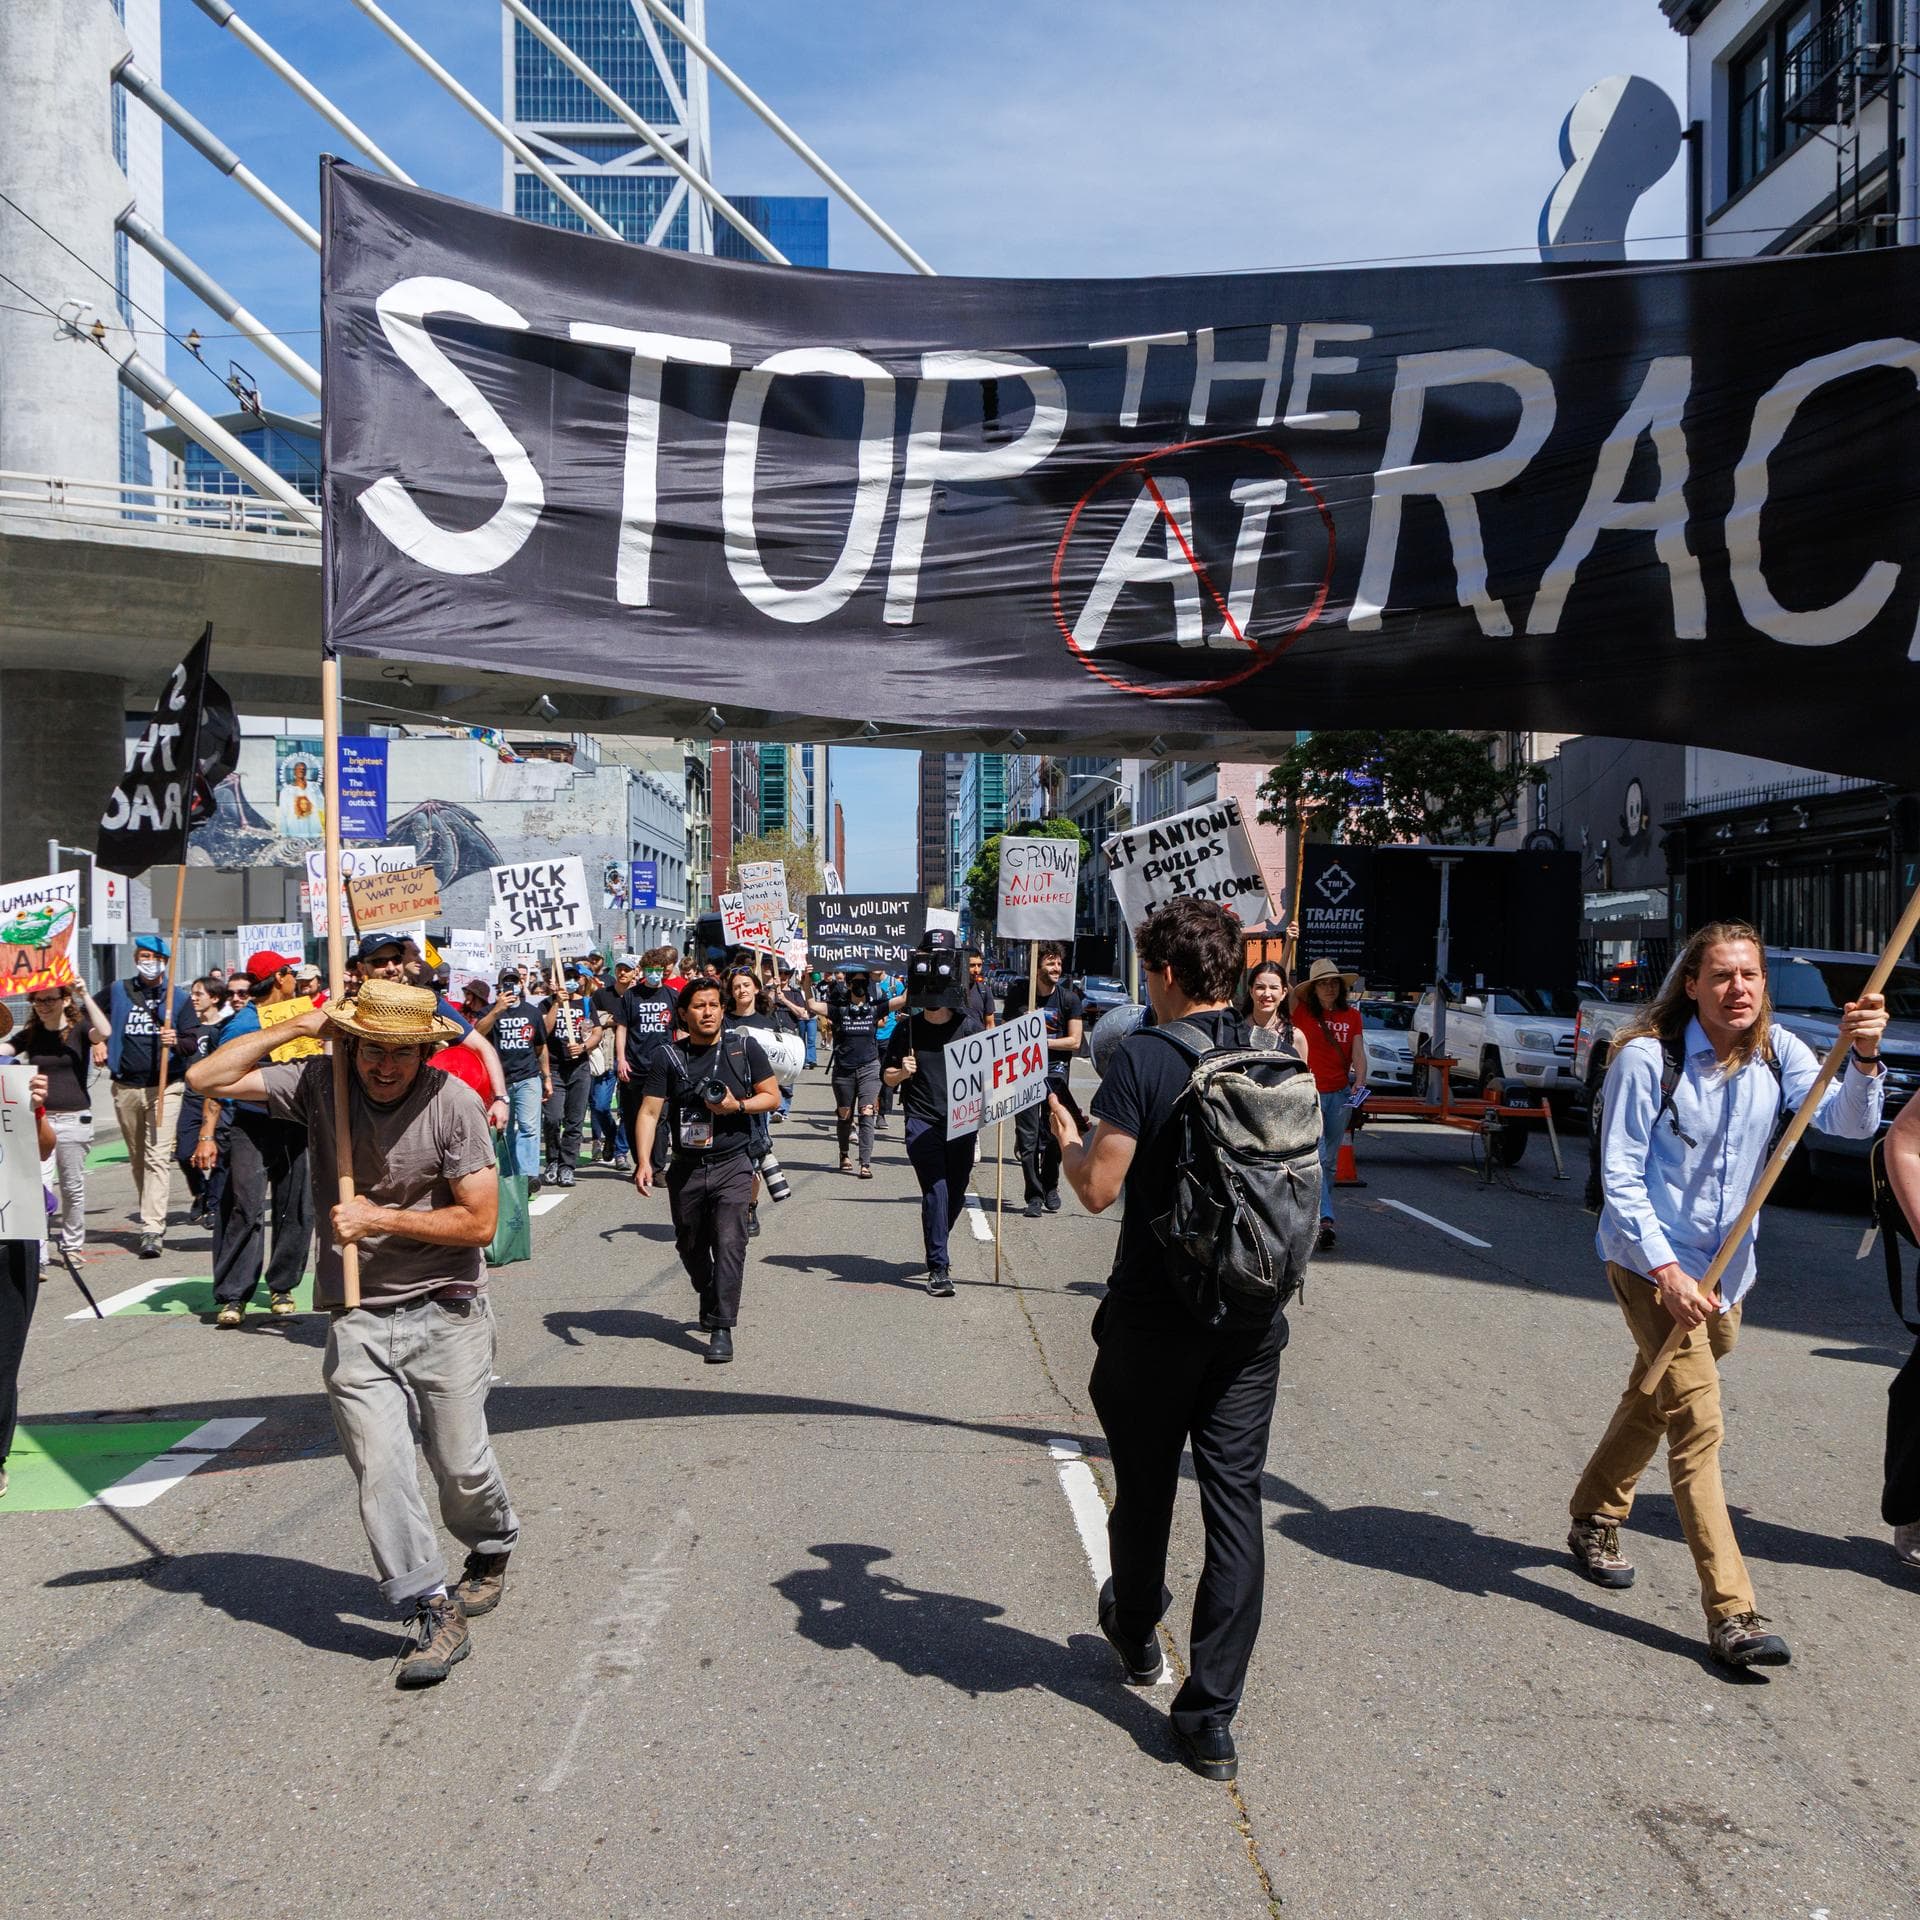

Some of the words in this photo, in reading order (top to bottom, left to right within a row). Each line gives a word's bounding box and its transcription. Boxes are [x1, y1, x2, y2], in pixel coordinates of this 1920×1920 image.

[1089, 323, 1374, 431] THE
[356, 275, 1068, 625] STOP
[1347, 337, 1920, 663] RAC
[1072, 476, 1288, 651] AI
[1110, 836, 1136, 871] IF
[1149, 803, 1241, 853] ANYONE
[310, 852, 366, 878] COs
[1006, 845, 1077, 878] GROWN
[1143, 838, 1224, 881] BUILDS
[352, 876, 384, 893] DON'T
[386, 872, 410, 883] CALL
[410, 870, 425, 879] UP
[497, 864, 566, 893] FUCK
[1010, 873, 1055, 892] NOT
[1169, 868, 1196, 893] IT
[1327, 880, 1343, 888] TMI
[0, 884, 75, 914] UMANITY
[365, 887, 395, 901] WHAT
[401, 883, 424, 895] YOU
[503, 887, 565, 912] THIS
[1005, 893, 1073, 906] ENGINEERED
[390, 901, 411, 914] PUT
[413, 896, 440, 910] DOWN
[722, 896, 743, 910] We
[819, 901, 841, 918] YOU
[849, 901, 910, 918] WOULDN'T
[510, 903, 579, 937] SHIT
[1306, 908, 1365, 921] TRAFFIC
[731, 922, 770, 939] Treaty
[819, 924, 877, 936] DOWNLOAD
[885, 924, 906, 936] THE
[1307, 922, 1364, 930] MANAGEMENT
[12, 945, 52, 975] AI
[811, 945, 870, 961] TORMENT
[874, 945, 917, 961] NEXU
[639, 1002, 667, 1013] STOP
[127, 1012, 153, 1023] THE
[500, 1017, 529, 1028] STOP
[640, 1013, 659, 1023] THE
[1318, 1020, 1350, 1032] TOP
[500, 1028, 522, 1039] THE
[640, 1023, 666, 1033] RACE
[500, 1039, 529, 1049] RACE
[951, 1028, 1012, 1069] VOTE
[1018, 1016, 1041, 1044] NO
[953, 1071, 984, 1101] ON
[993, 1043, 1043, 1089] FISA
[952, 1105, 967, 1121] NO
[969, 1098, 982, 1115] AI
